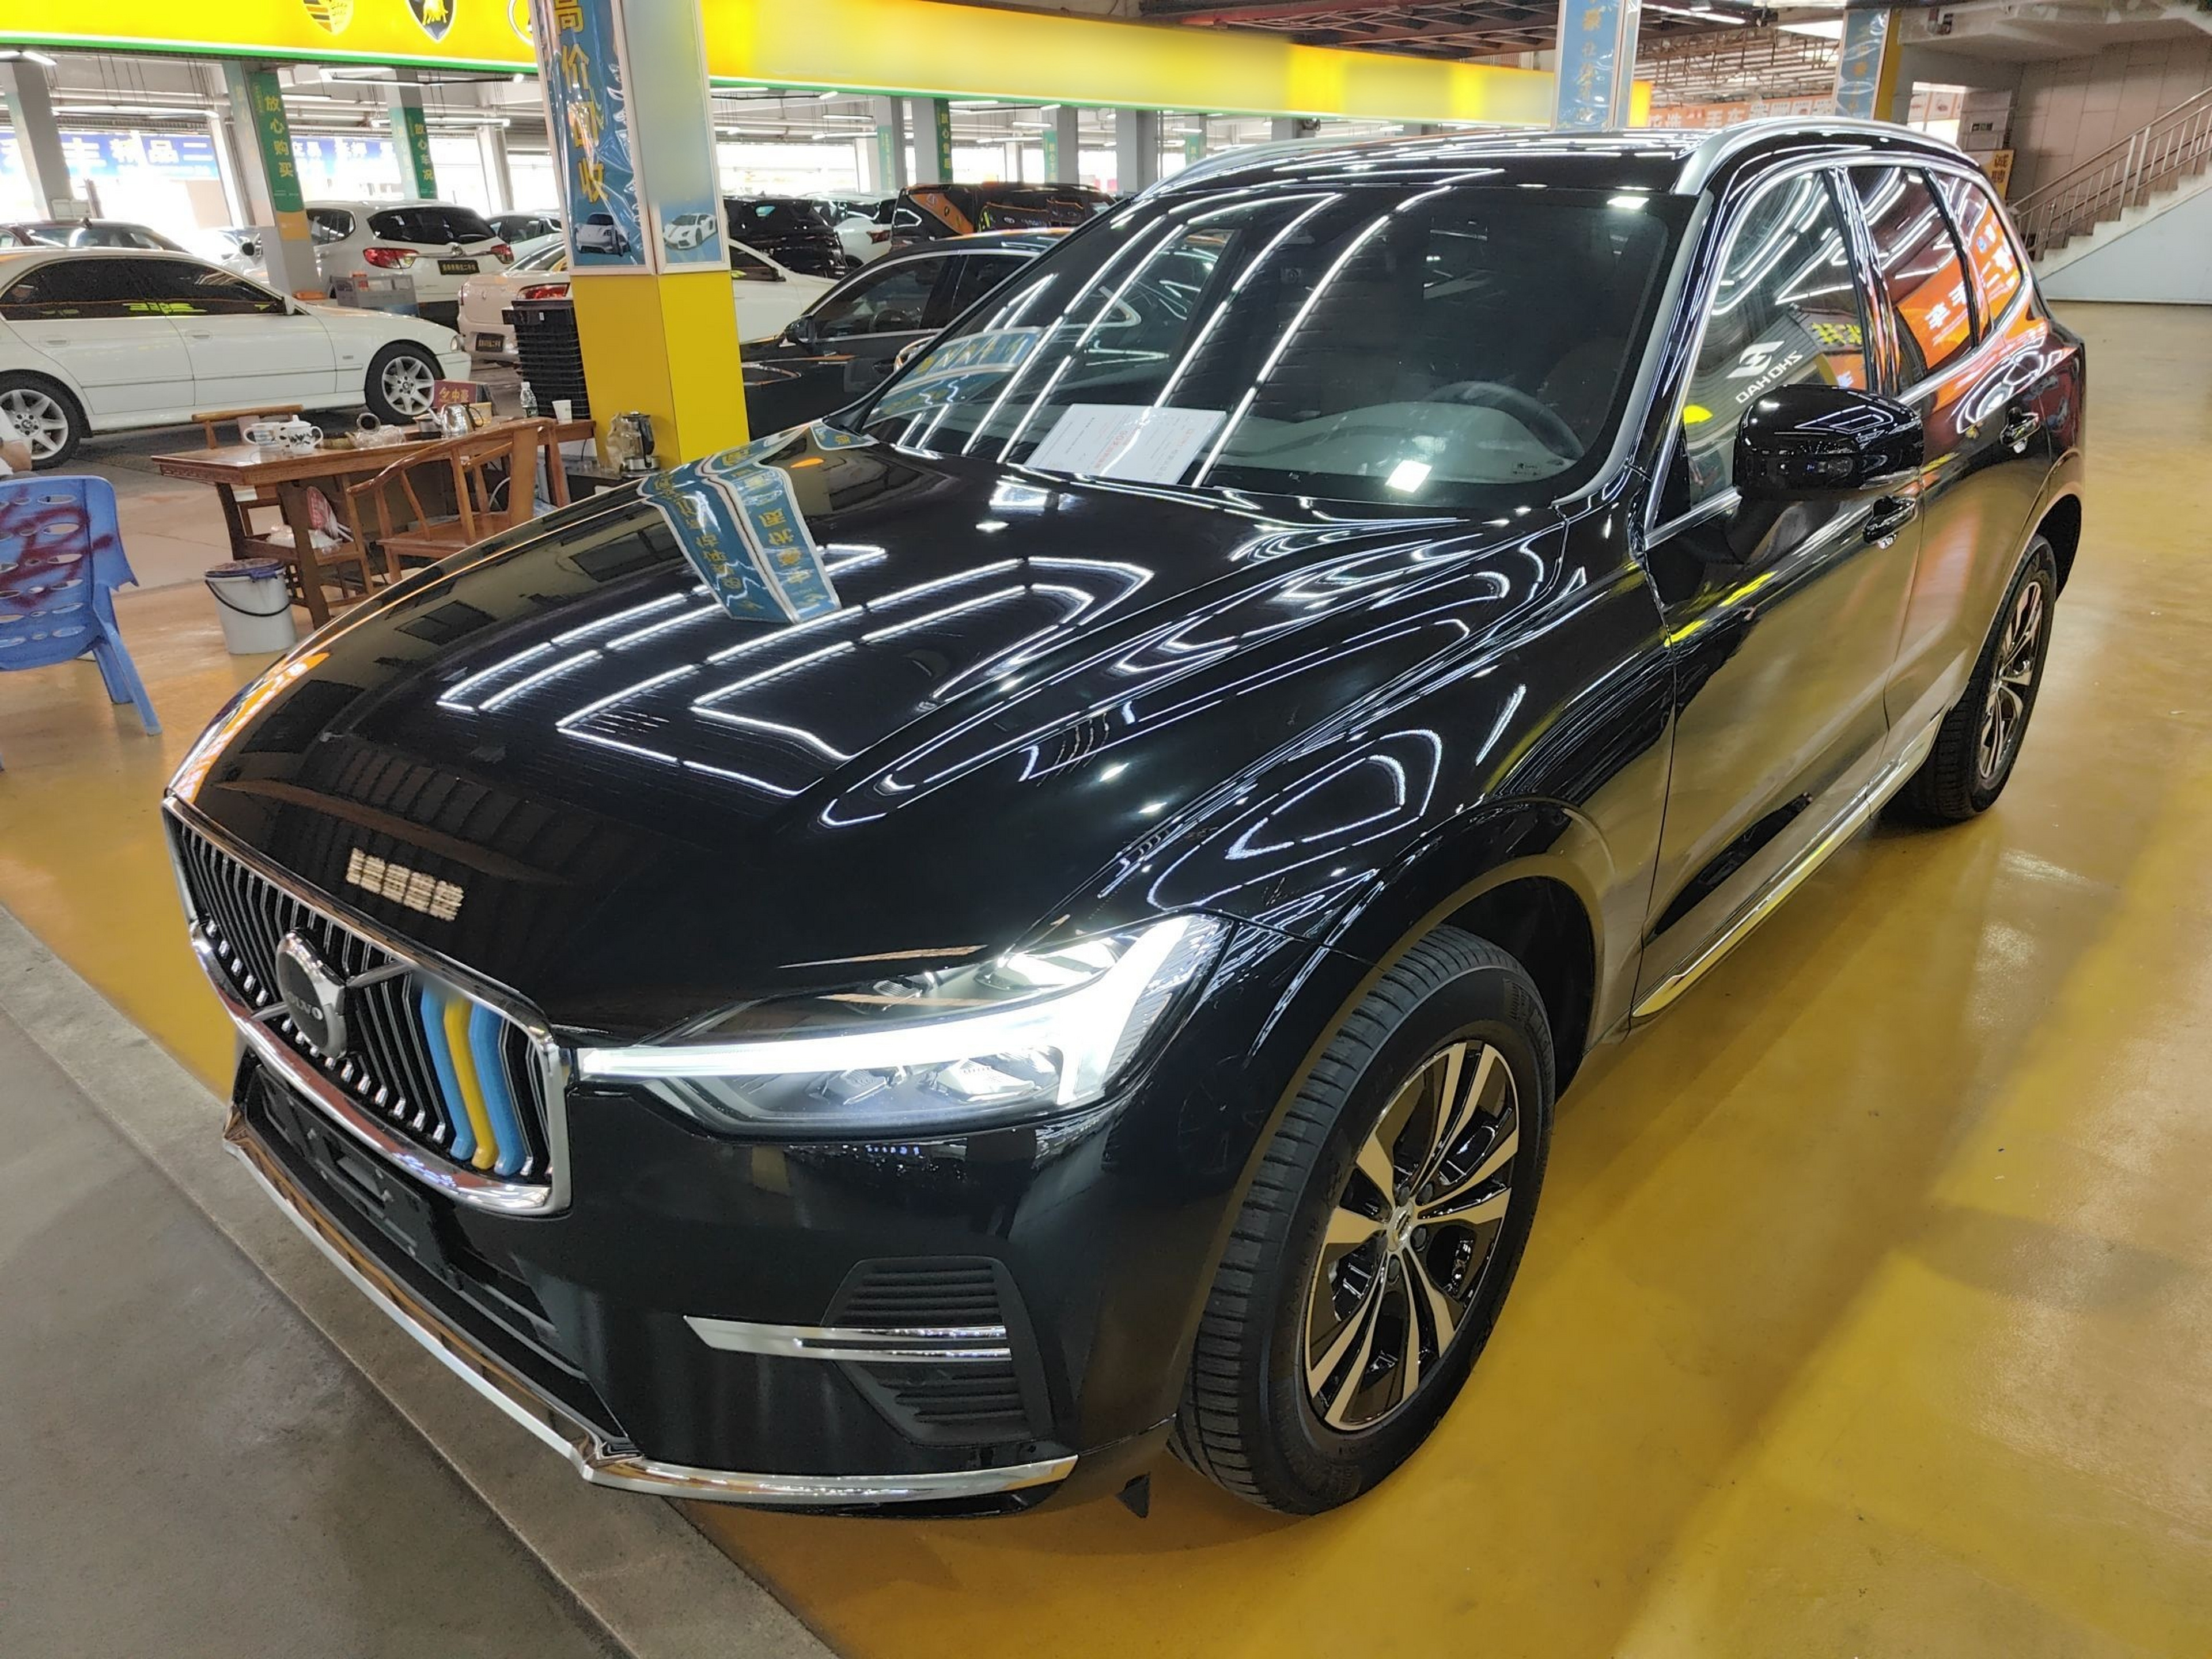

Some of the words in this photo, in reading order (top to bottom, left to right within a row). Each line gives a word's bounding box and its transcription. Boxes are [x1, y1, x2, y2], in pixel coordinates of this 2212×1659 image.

[264, 95, 294, 177] 放心购买
[414, 123, 434, 181] 放心车况
